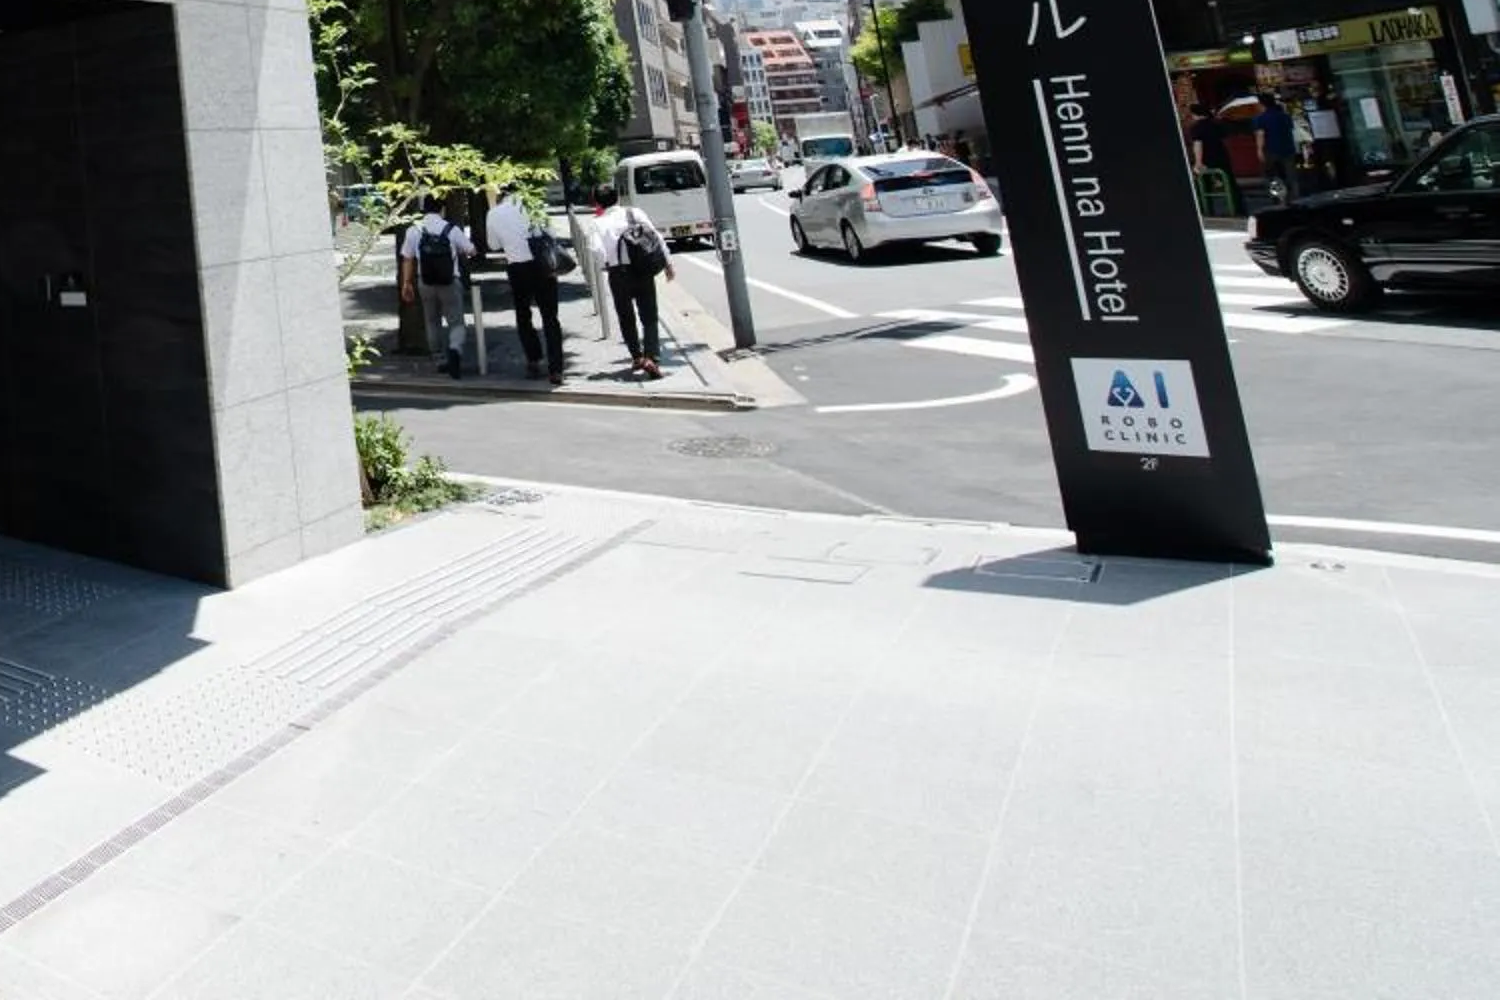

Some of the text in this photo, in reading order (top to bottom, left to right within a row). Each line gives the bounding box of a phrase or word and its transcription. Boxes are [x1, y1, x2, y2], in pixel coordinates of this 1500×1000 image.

[1050, 75, 1140, 322] Henn na Hotel
[1107, 369, 1169, 408] AI
[1100, 415, 1183, 429] ROBO
[1104, 430, 1187, 444] CLINIC
